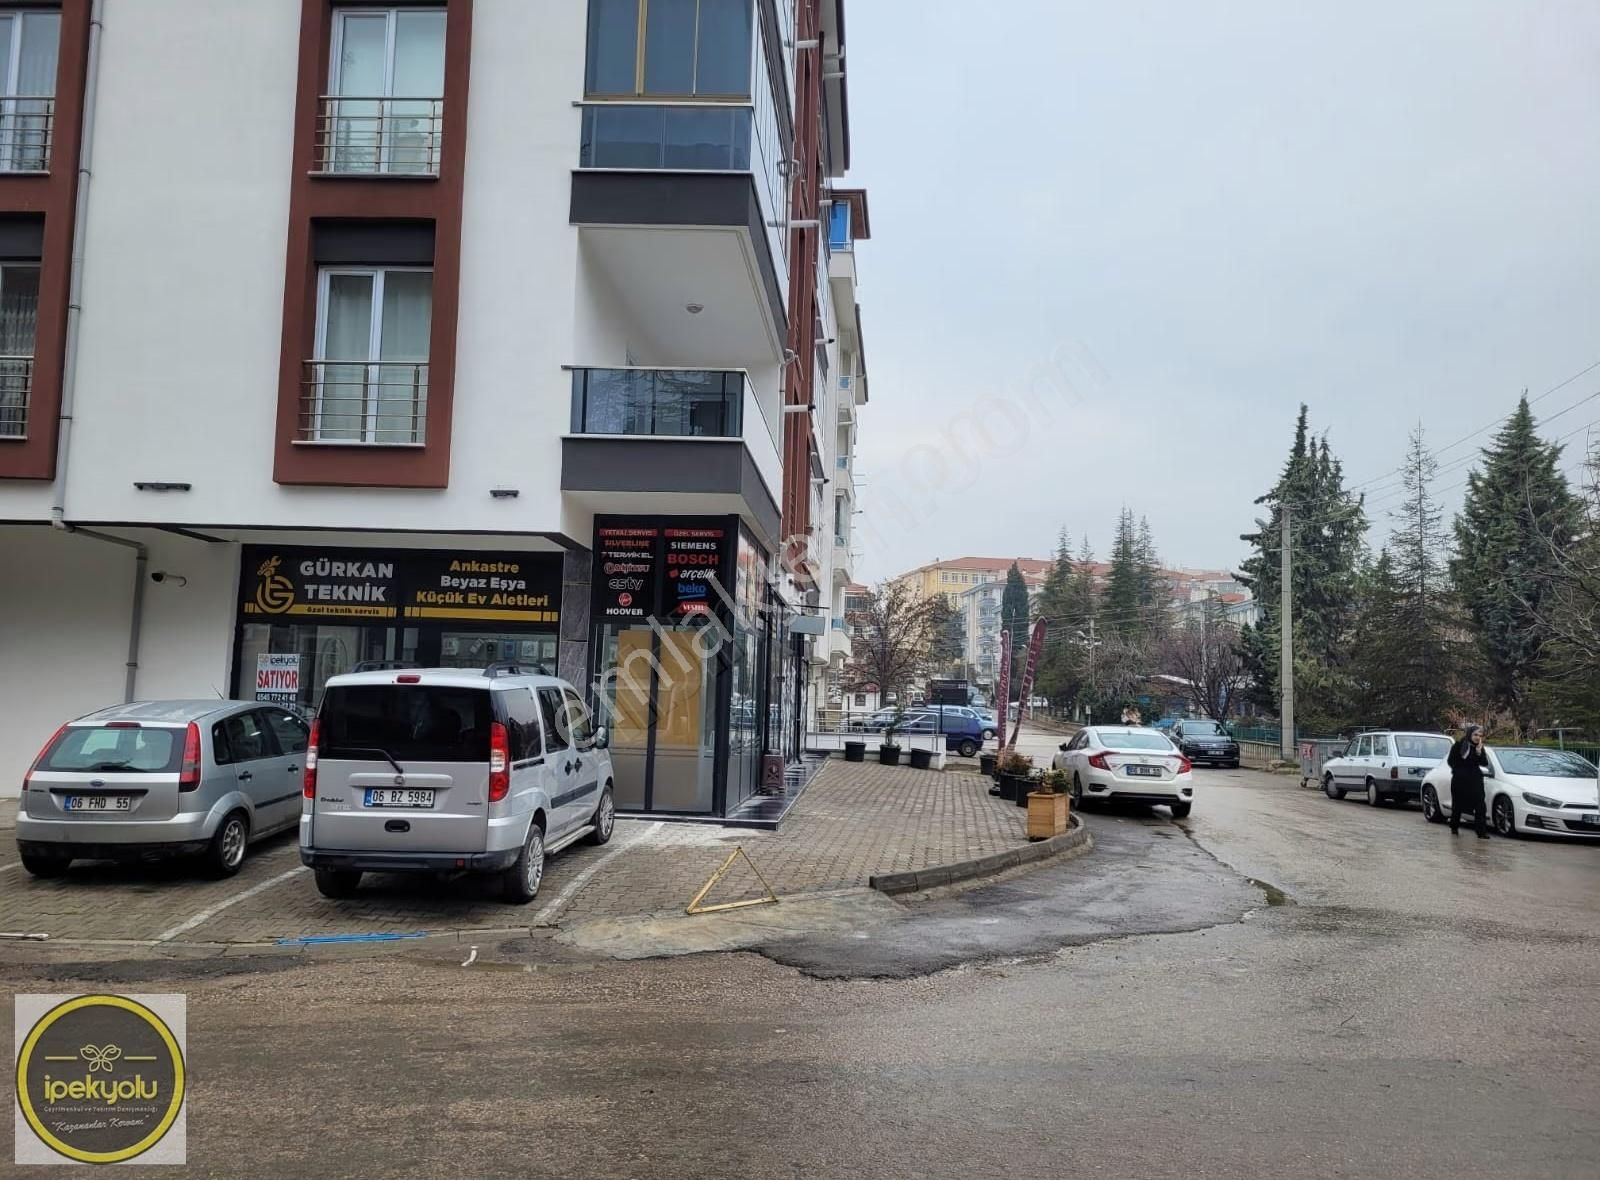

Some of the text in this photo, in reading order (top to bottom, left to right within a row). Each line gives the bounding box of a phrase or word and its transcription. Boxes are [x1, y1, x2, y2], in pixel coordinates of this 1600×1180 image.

[671, 542, 717, 550] SIEMENS
[667, 554, 719, 565] BOSCH
[300, 557, 394, 578] GÜRKAN
[450, 560, 519, 574] Ankastre
[680, 568, 716, 580] arçelik
[440, 575, 526, 591] Beyaz Eşya
[608, 576, 644, 591] esty
[678, 582, 706, 593] beko
[304, 582, 387, 602] TEKNİK
[416, 590, 548, 607] Küçük Ev Aletleri
[258, 670, 298, 688] SATIYOR
[71, 797, 83, 808] 06
[116, 797, 128, 808] 55
[372, 790, 432, 803] 06 BZ 5984
